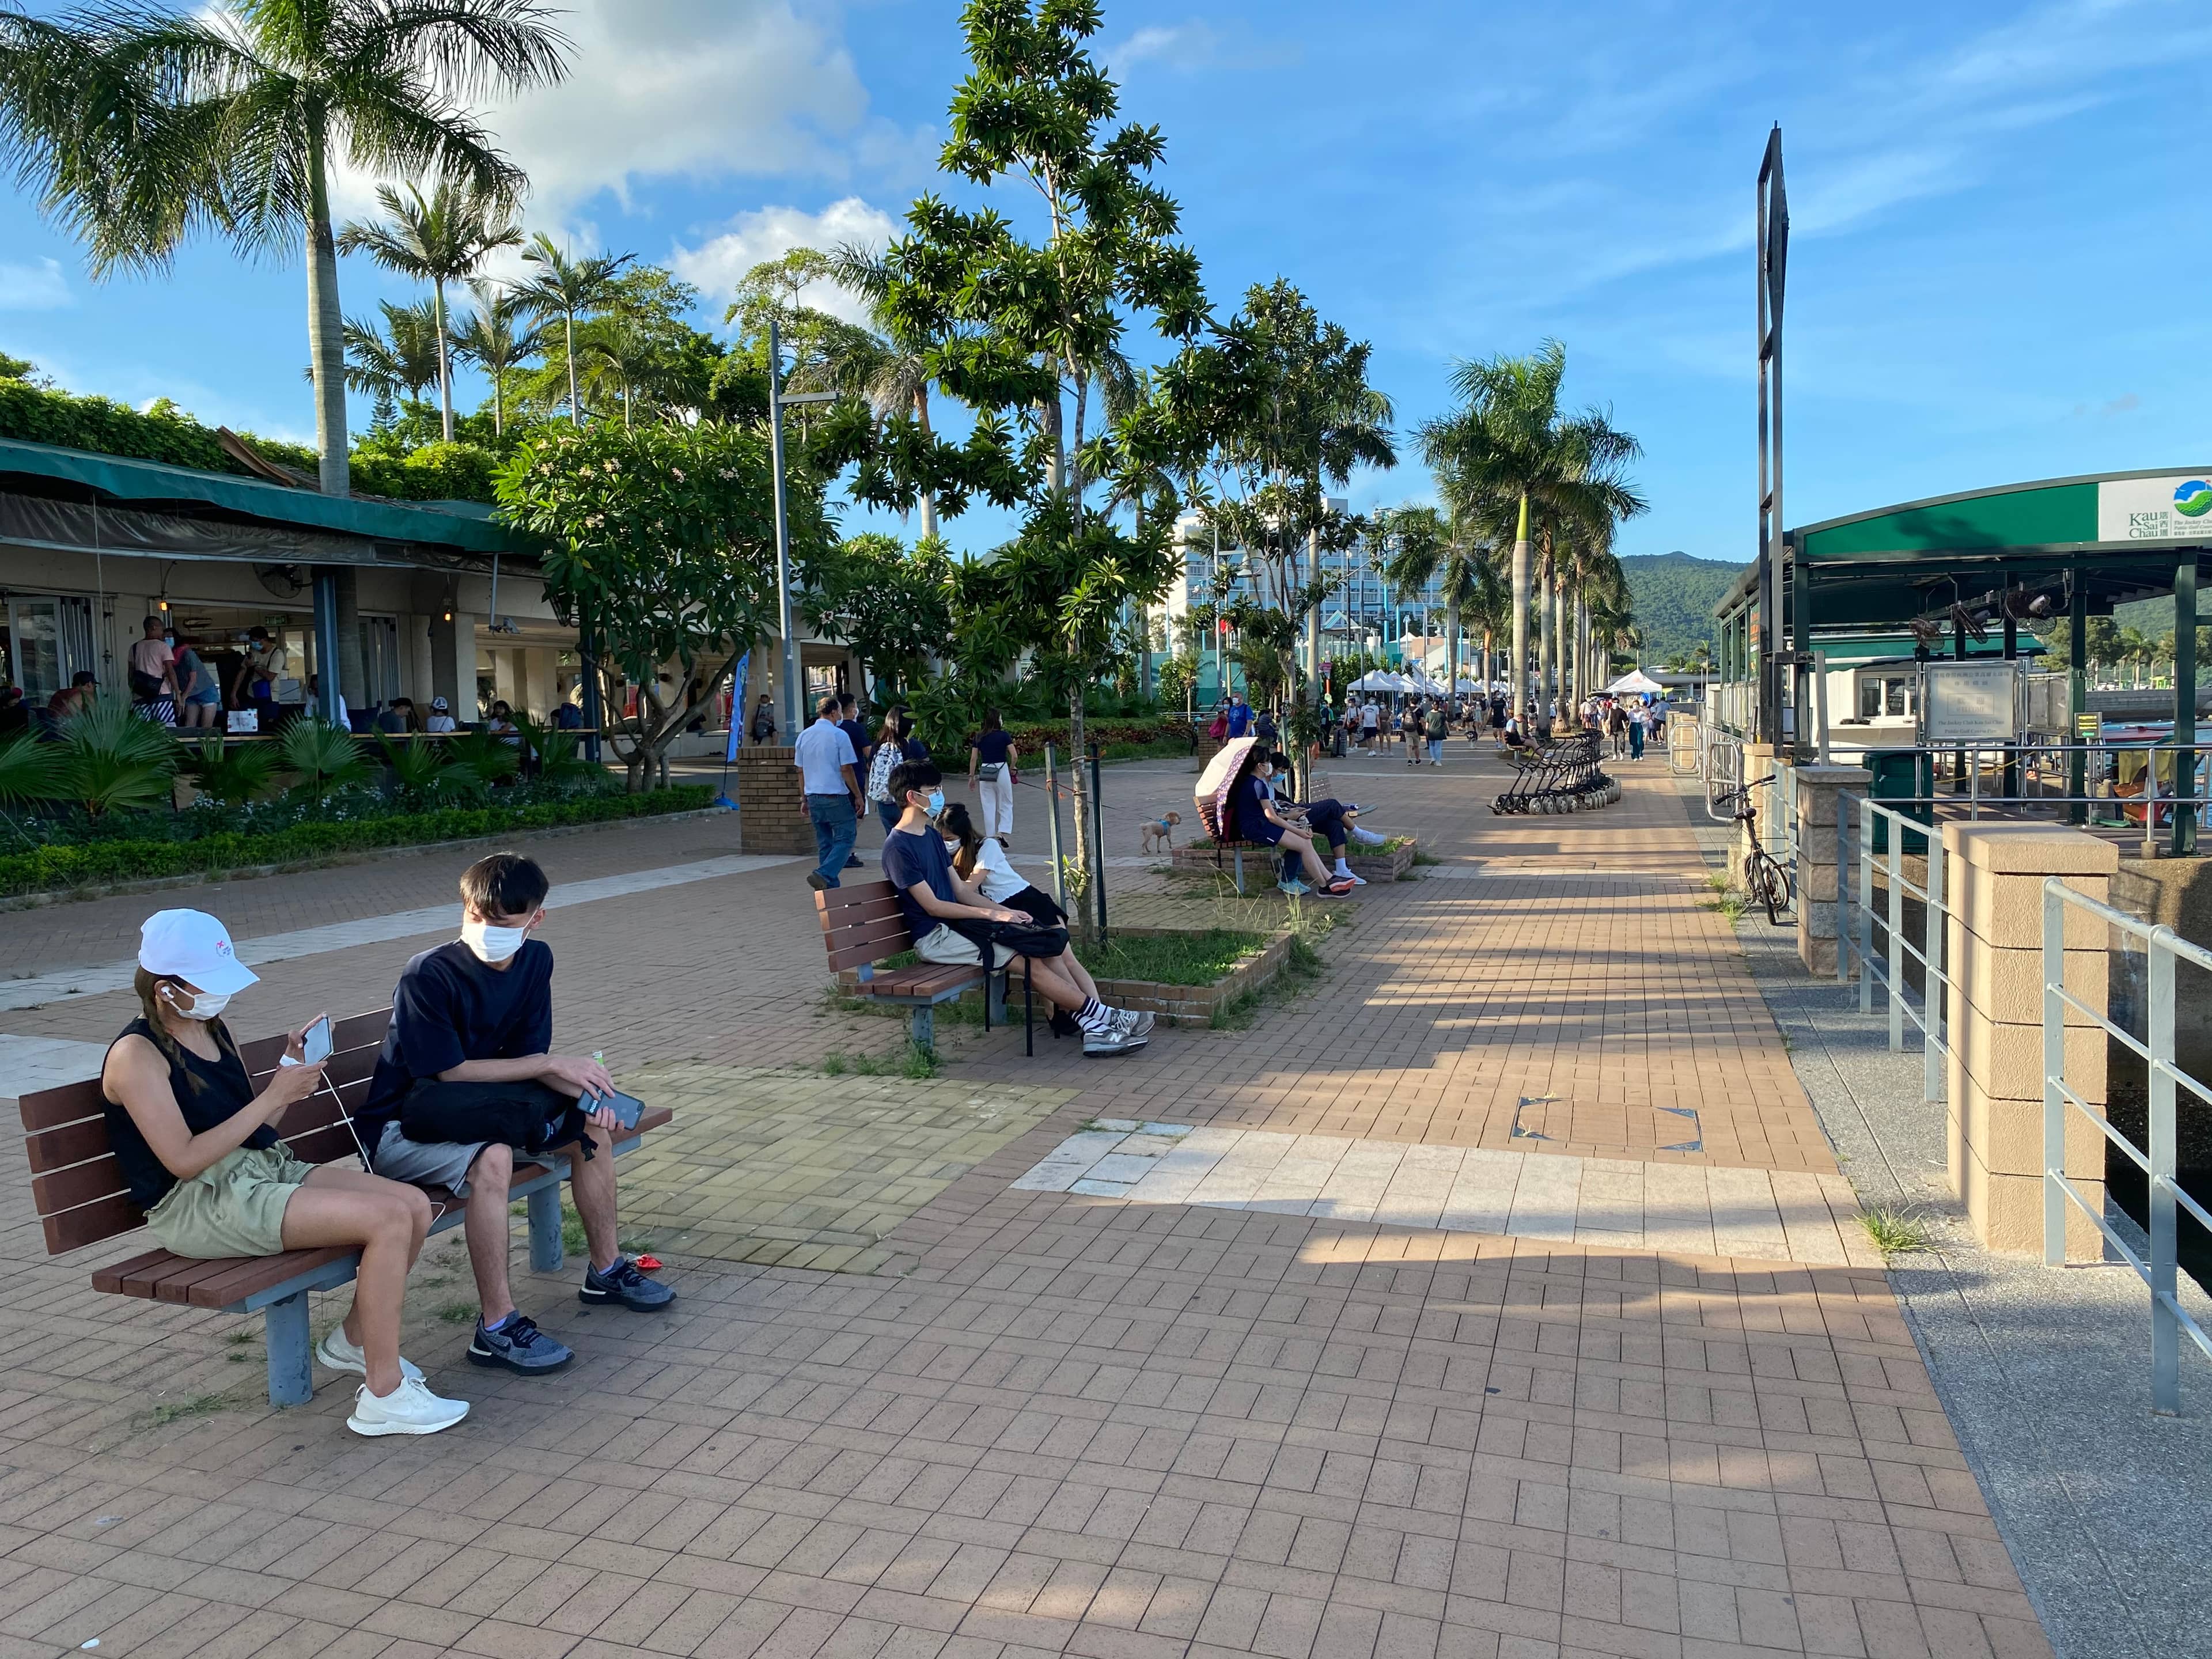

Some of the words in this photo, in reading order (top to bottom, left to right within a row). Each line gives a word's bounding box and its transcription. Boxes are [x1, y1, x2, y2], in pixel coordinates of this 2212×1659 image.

[2129, 512, 2158, 527] Kau
[2143, 521, 2158, 531] Sai
[2129, 528, 2158, 539] Chau
[1109, 1032, 1122, 1043] N
